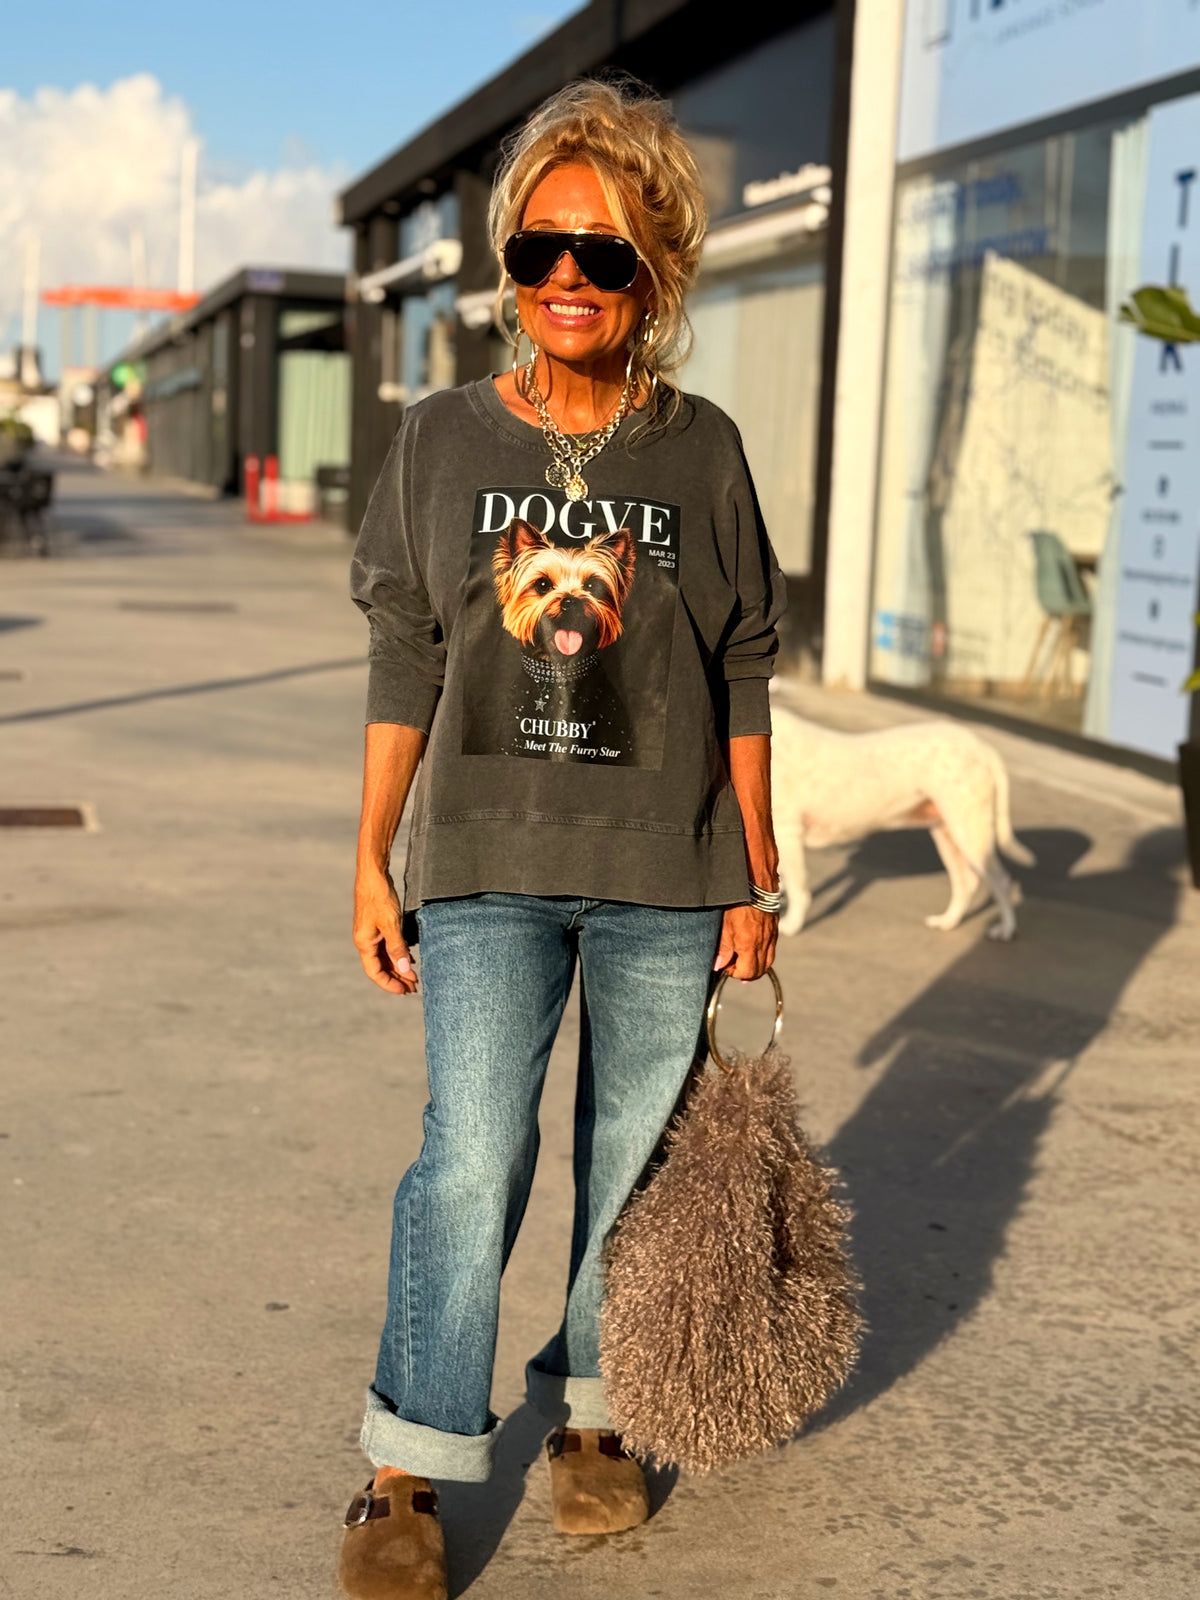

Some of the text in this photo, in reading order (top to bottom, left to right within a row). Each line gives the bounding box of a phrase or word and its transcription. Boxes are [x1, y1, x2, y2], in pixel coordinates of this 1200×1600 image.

[478, 493, 671, 546] DOGVE
[648, 549, 676, 560] MAR 23
[657, 559, 676, 569] 2023
[520, 718, 592, 739] CHUBBY
[524, 740, 621, 758] Meet The Furry Star
